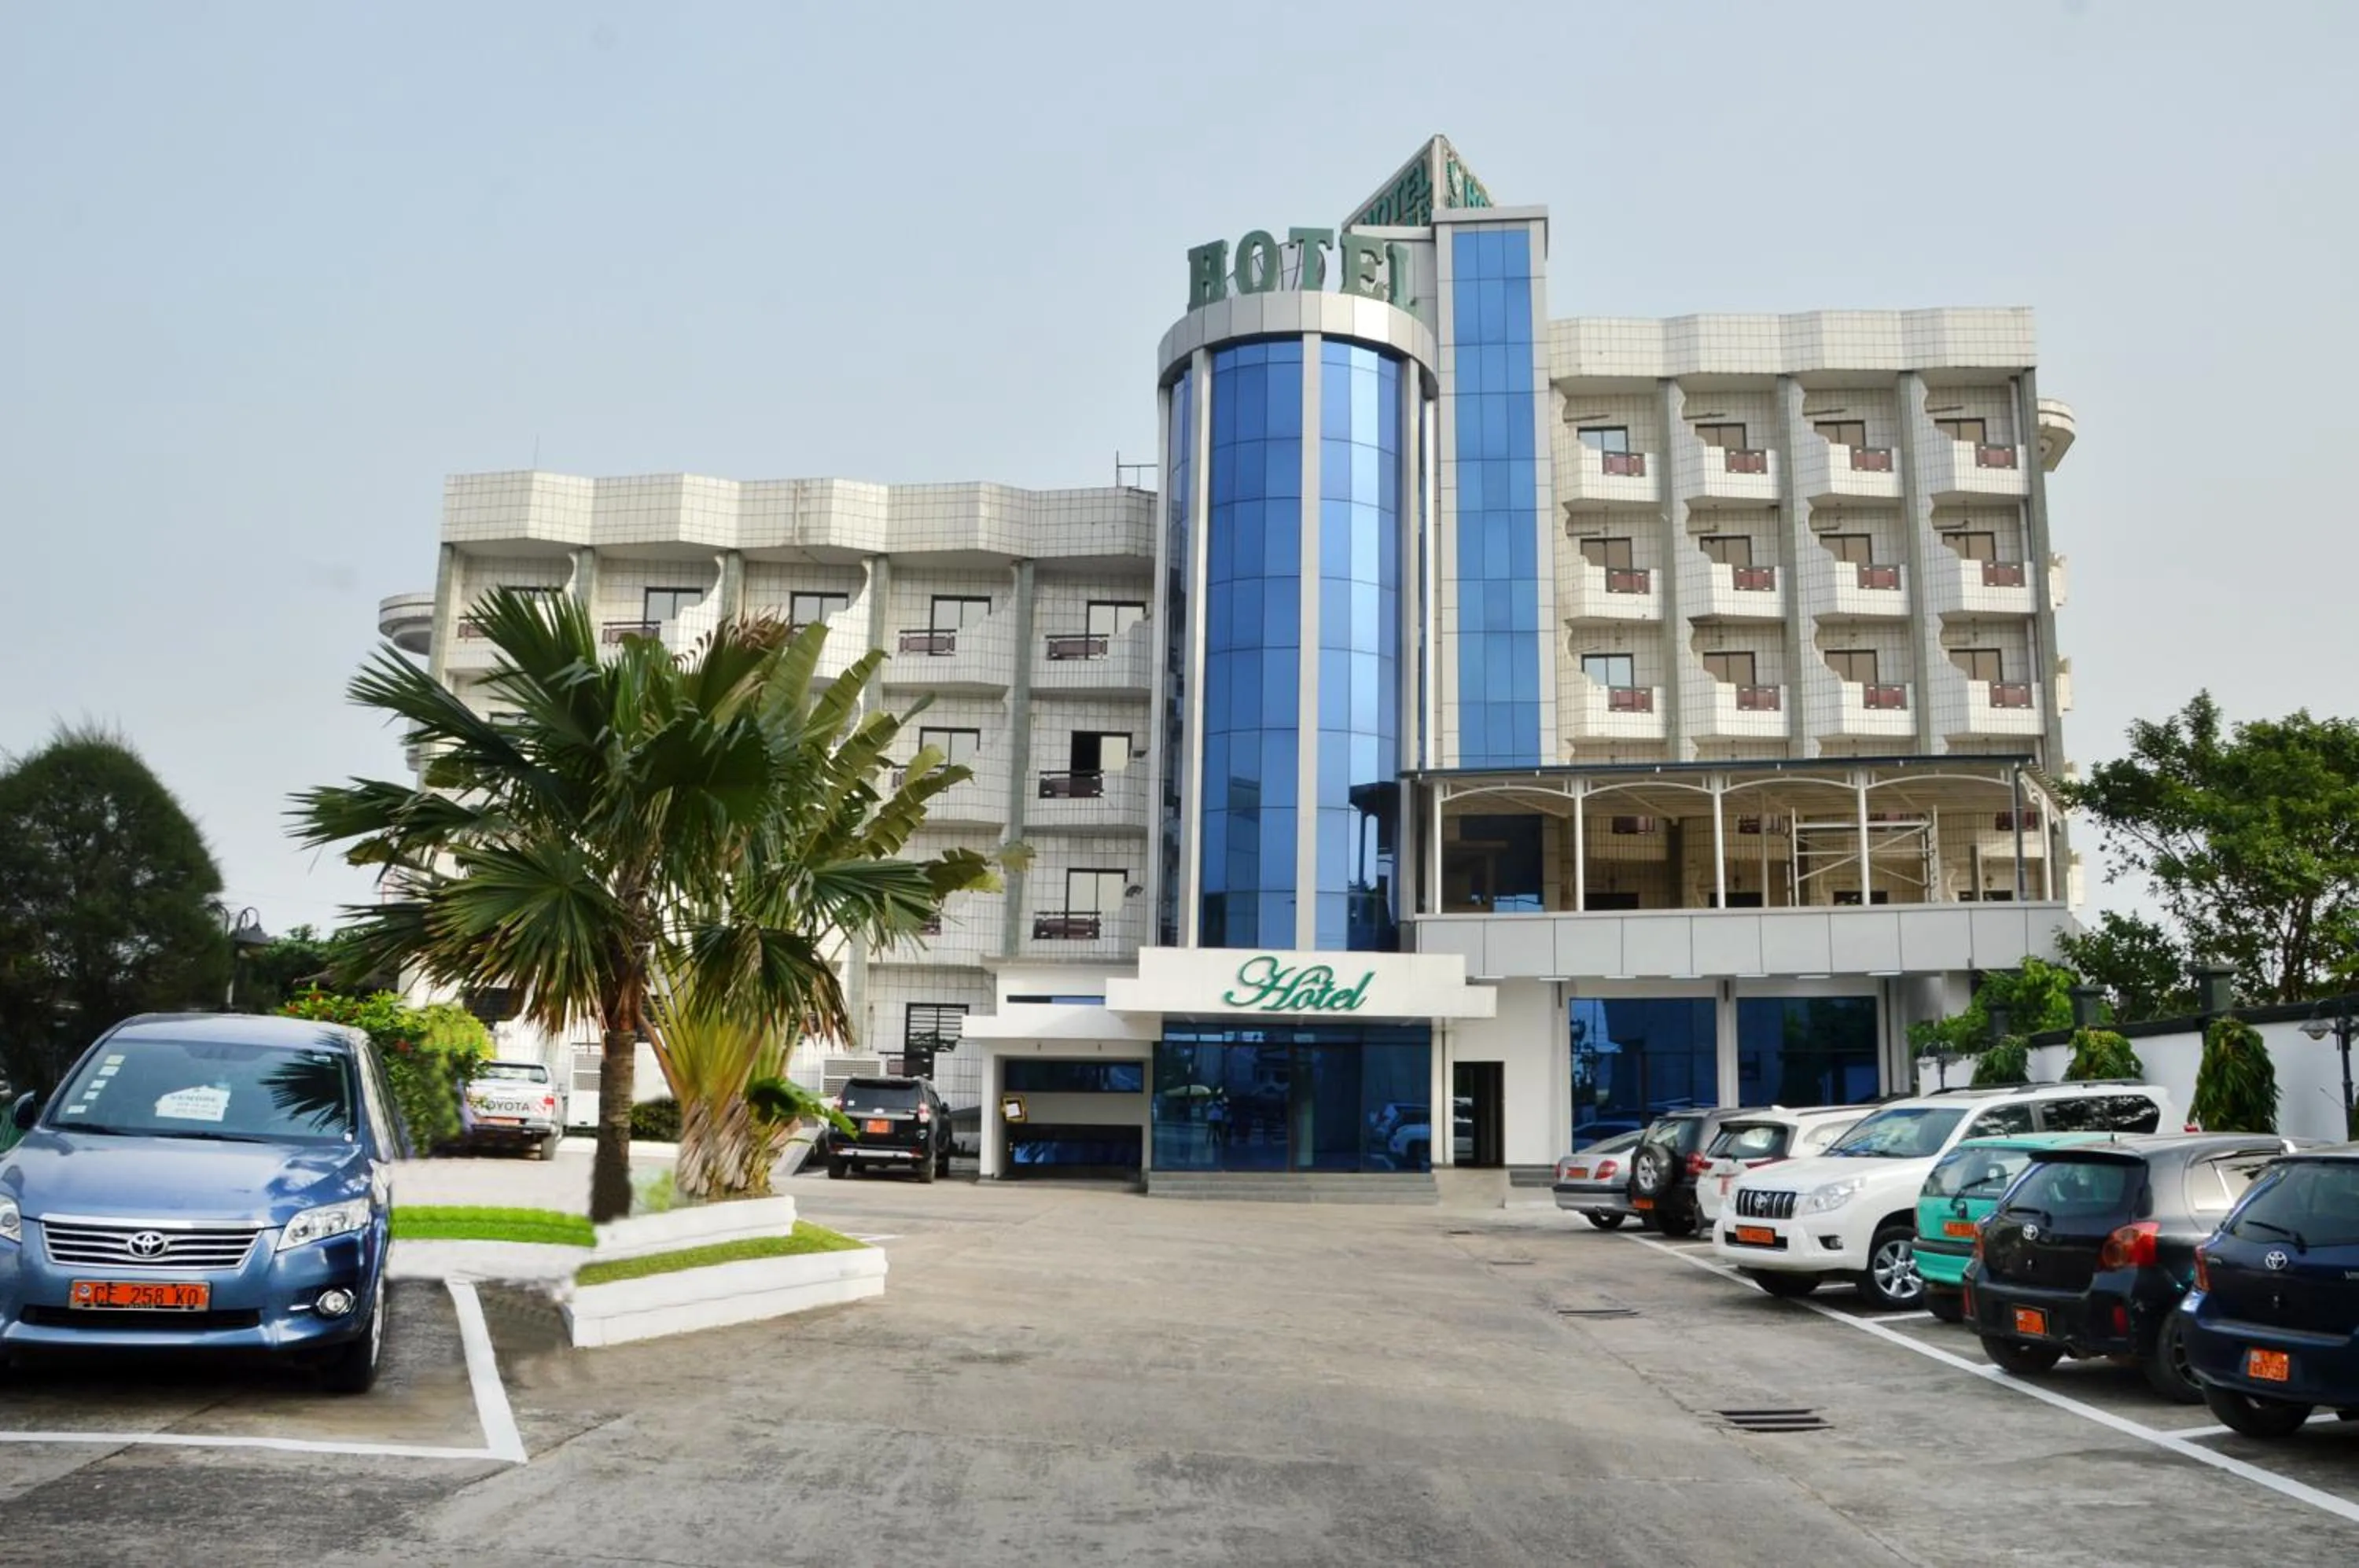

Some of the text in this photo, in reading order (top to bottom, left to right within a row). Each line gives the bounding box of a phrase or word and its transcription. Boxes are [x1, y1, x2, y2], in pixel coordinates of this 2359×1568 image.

[1187, 226, 1418, 317] HOTEL
[1224, 955, 1376, 1011] Hôtel
[481, 1100, 530, 1111] OYOTA
